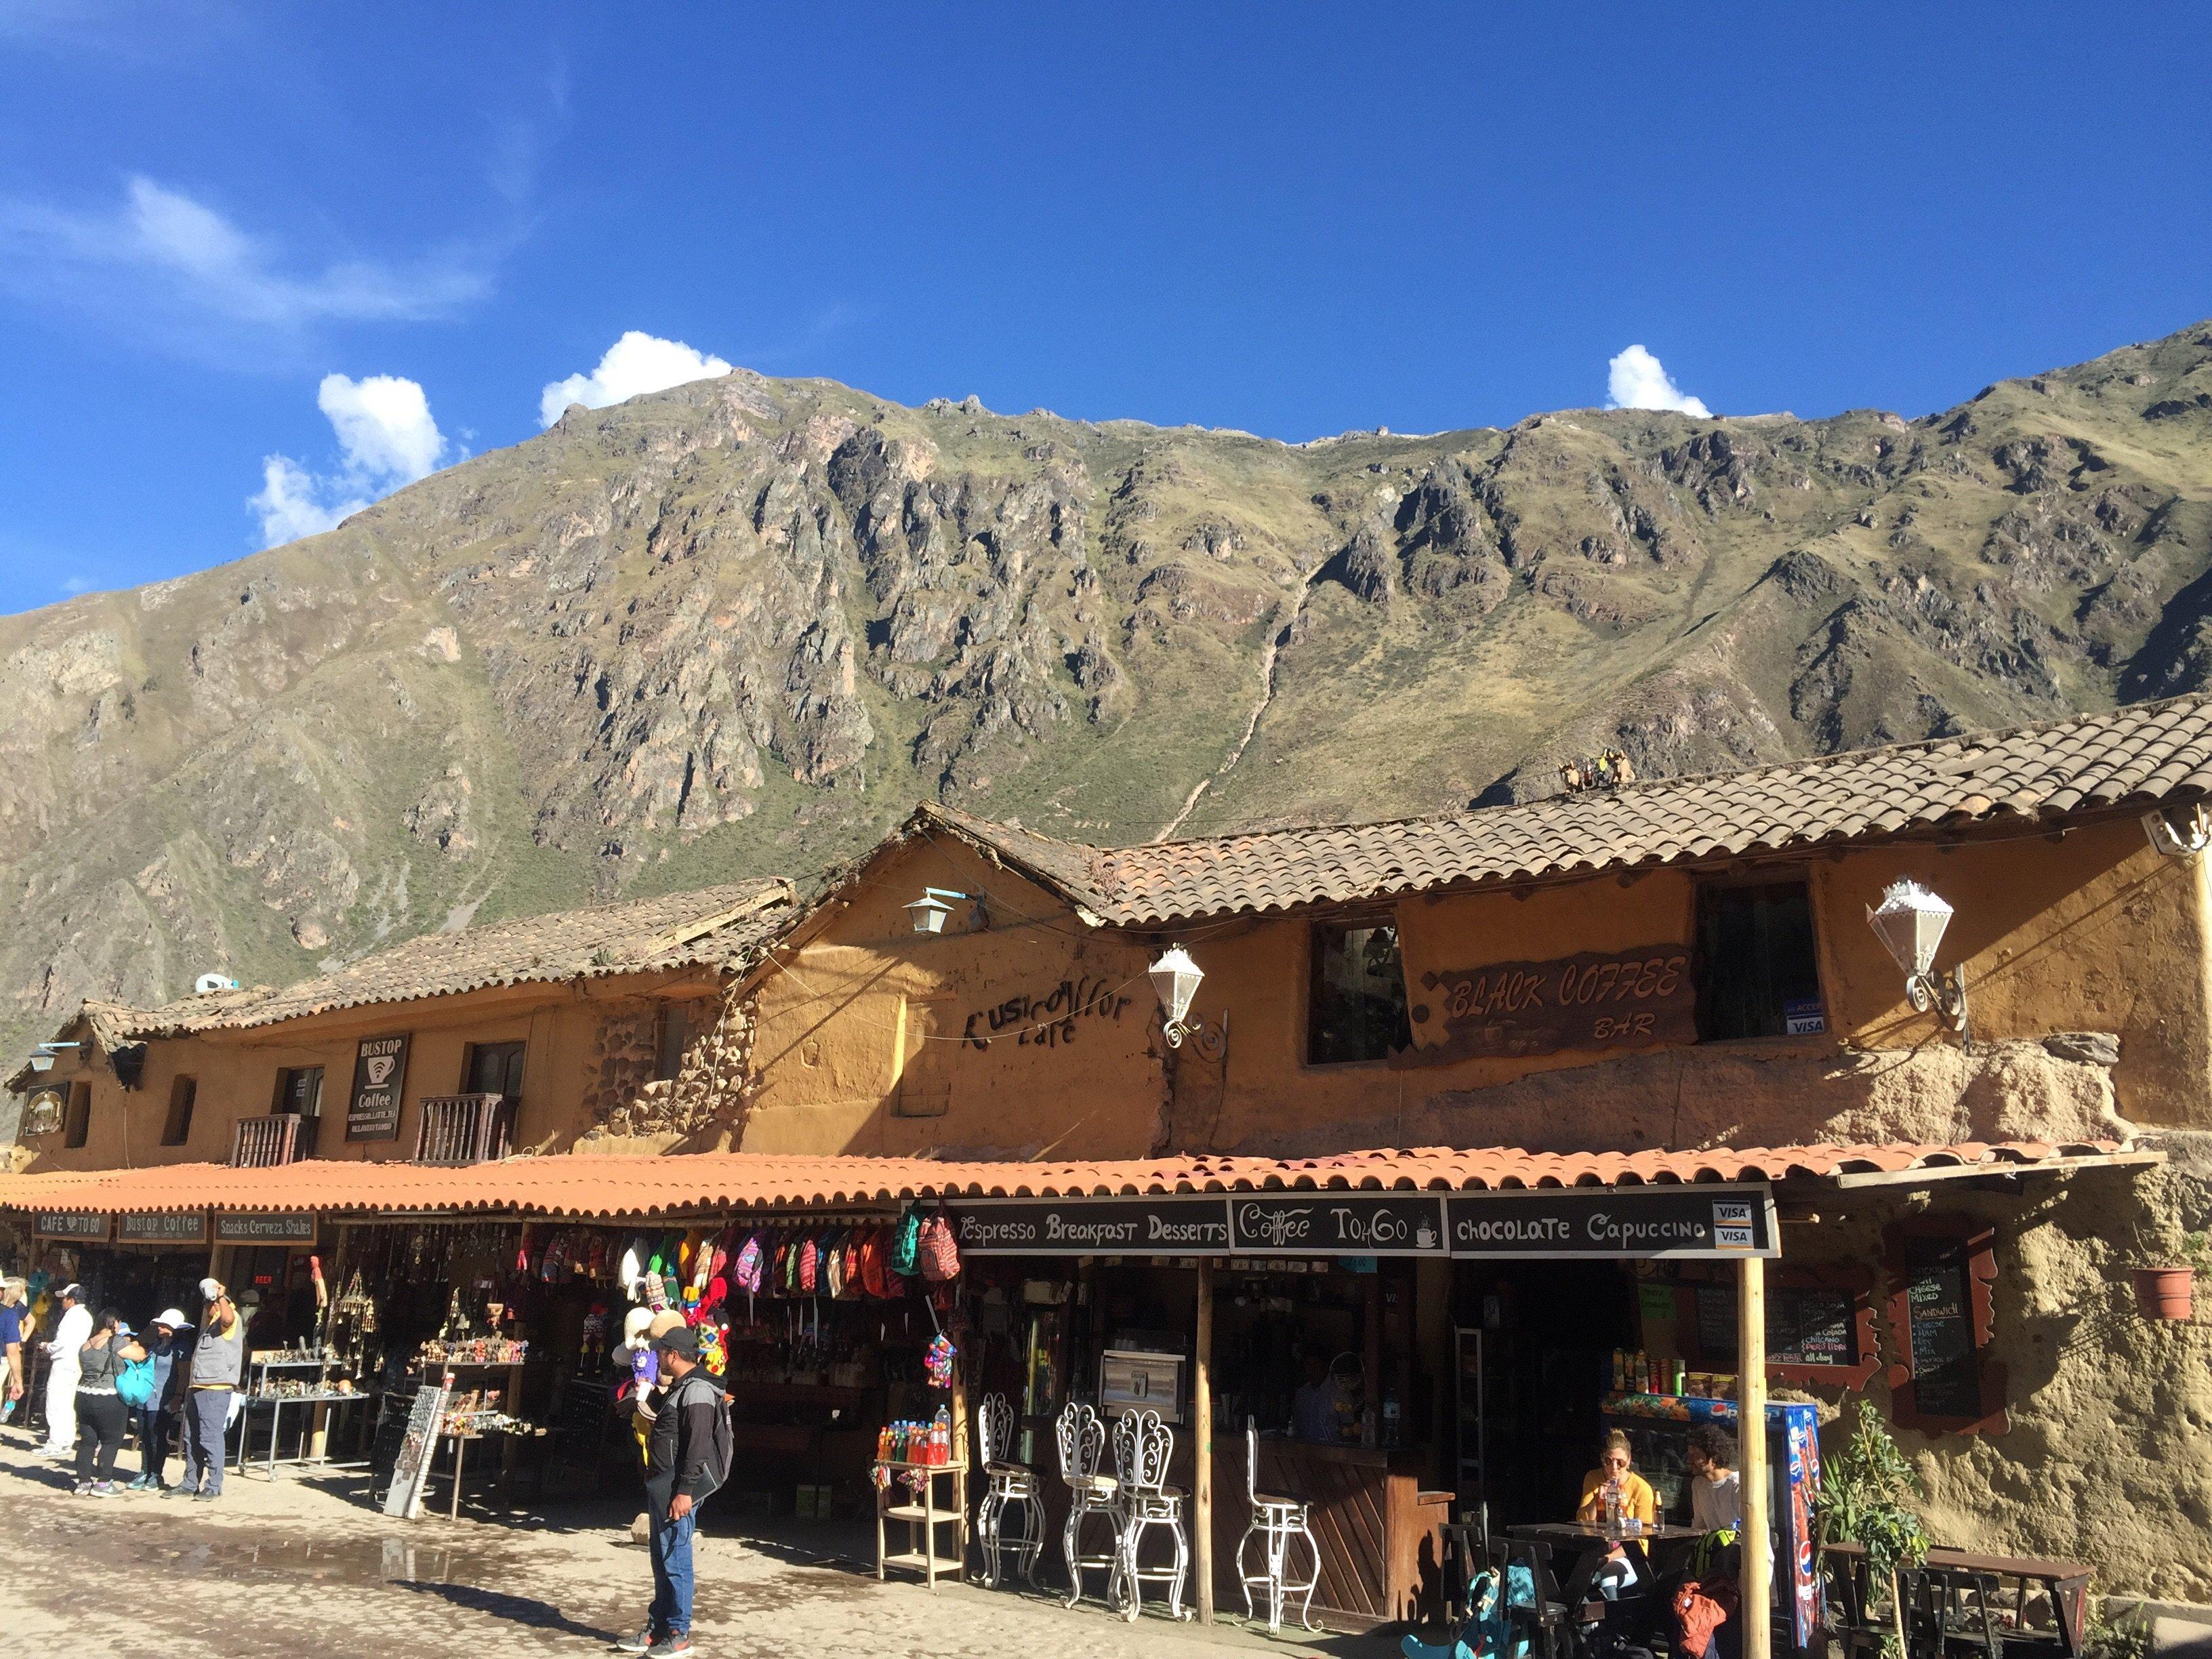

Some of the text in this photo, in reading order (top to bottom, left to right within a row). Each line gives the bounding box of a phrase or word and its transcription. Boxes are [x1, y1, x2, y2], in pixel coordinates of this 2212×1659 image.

[1451, 956, 1687, 1019] BLACK COFFEE
[1593, 1011, 1656, 1040] BAR
[1792, 1021, 1824, 1033] VISA
[361, 1039, 402, 1057] BUSTOP
[358, 1092, 392, 1108] Coffee
[1718, 1206, 1747, 1218] VISA
[41, 1215, 100, 1233] CAFE TO GO
[163, 1215, 199, 1231] Coffee
[220, 1219, 248, 1234] Snacks
[249, 1220, 284, 1235] Cerveza
[1239, 1202, 1315, 1246] Coffee
[958, 1216, 1036, 1247] Espresso
[1721, 1230, 1748, 1242] VISA
[255, 1275, 272, 1284] BEER
